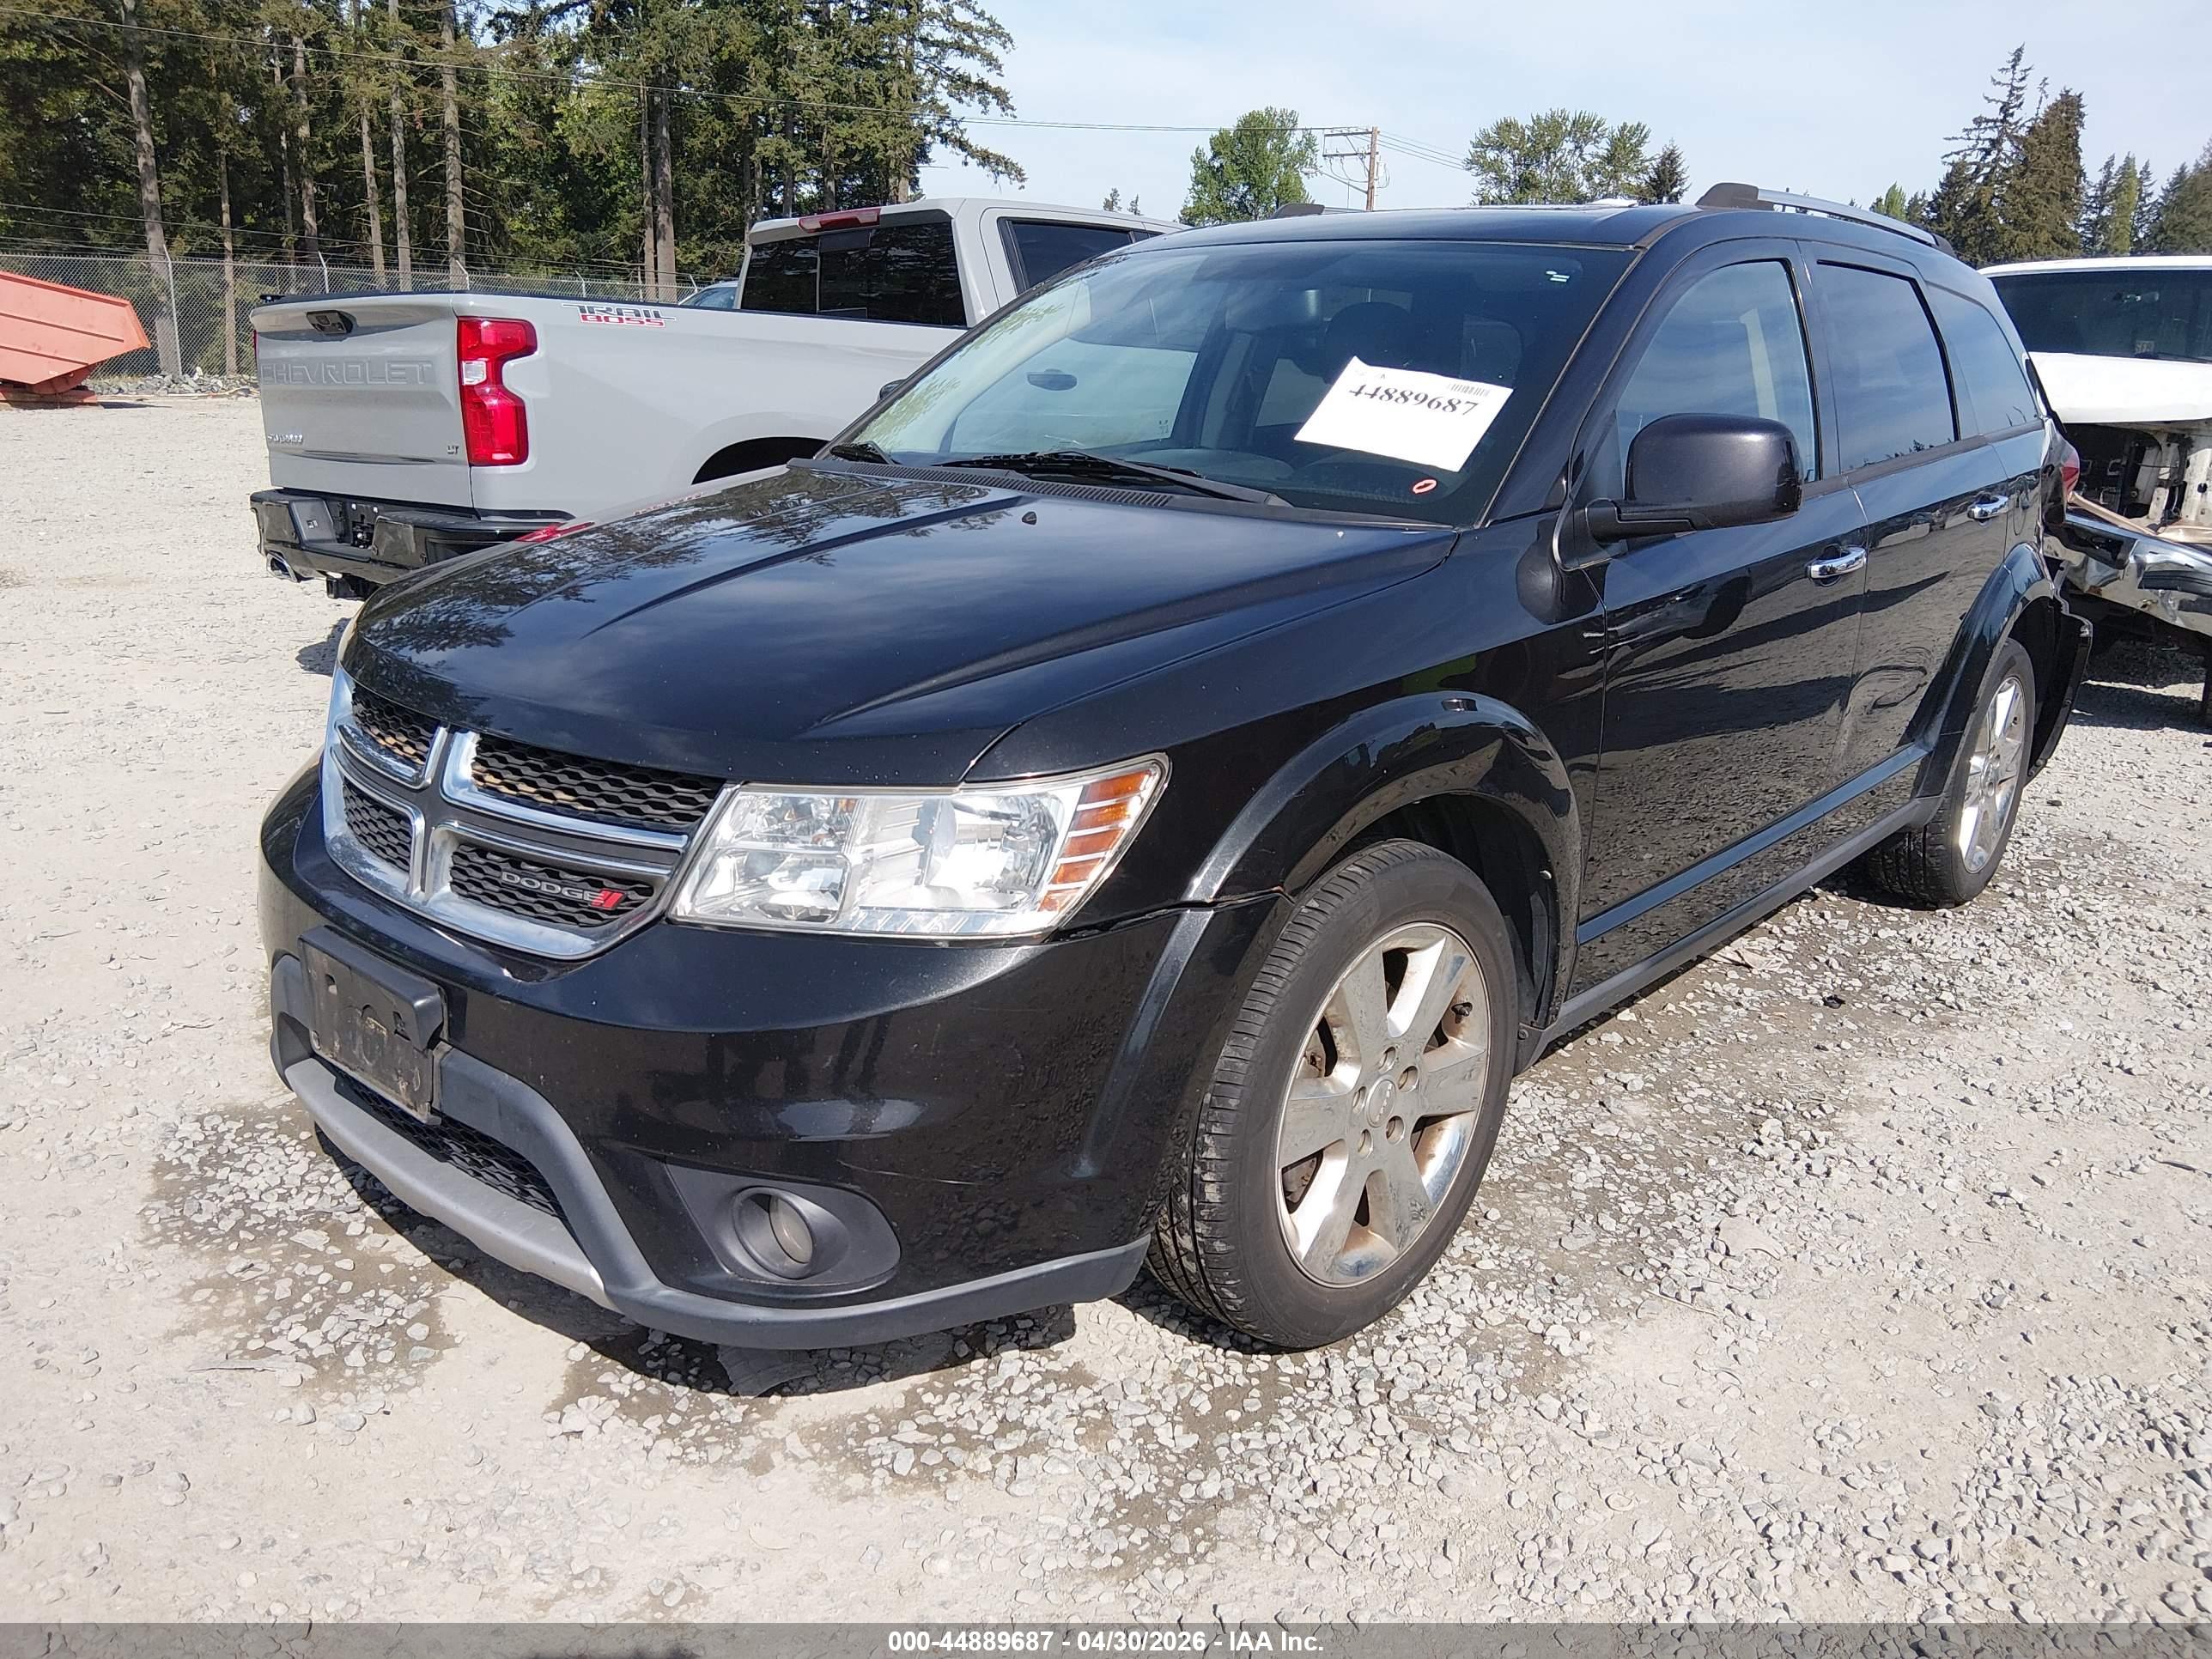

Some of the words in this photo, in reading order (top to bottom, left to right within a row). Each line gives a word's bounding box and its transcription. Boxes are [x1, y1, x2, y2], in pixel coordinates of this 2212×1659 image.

[562, 303, 677, 321] TRAIL
[579, 313, 665, 327] BOSS
[260, 360, 432, 385] CHEVROLET
[1349, 384, 1479, 416] 44889687
[501, 871, 605, 904] DODGE
